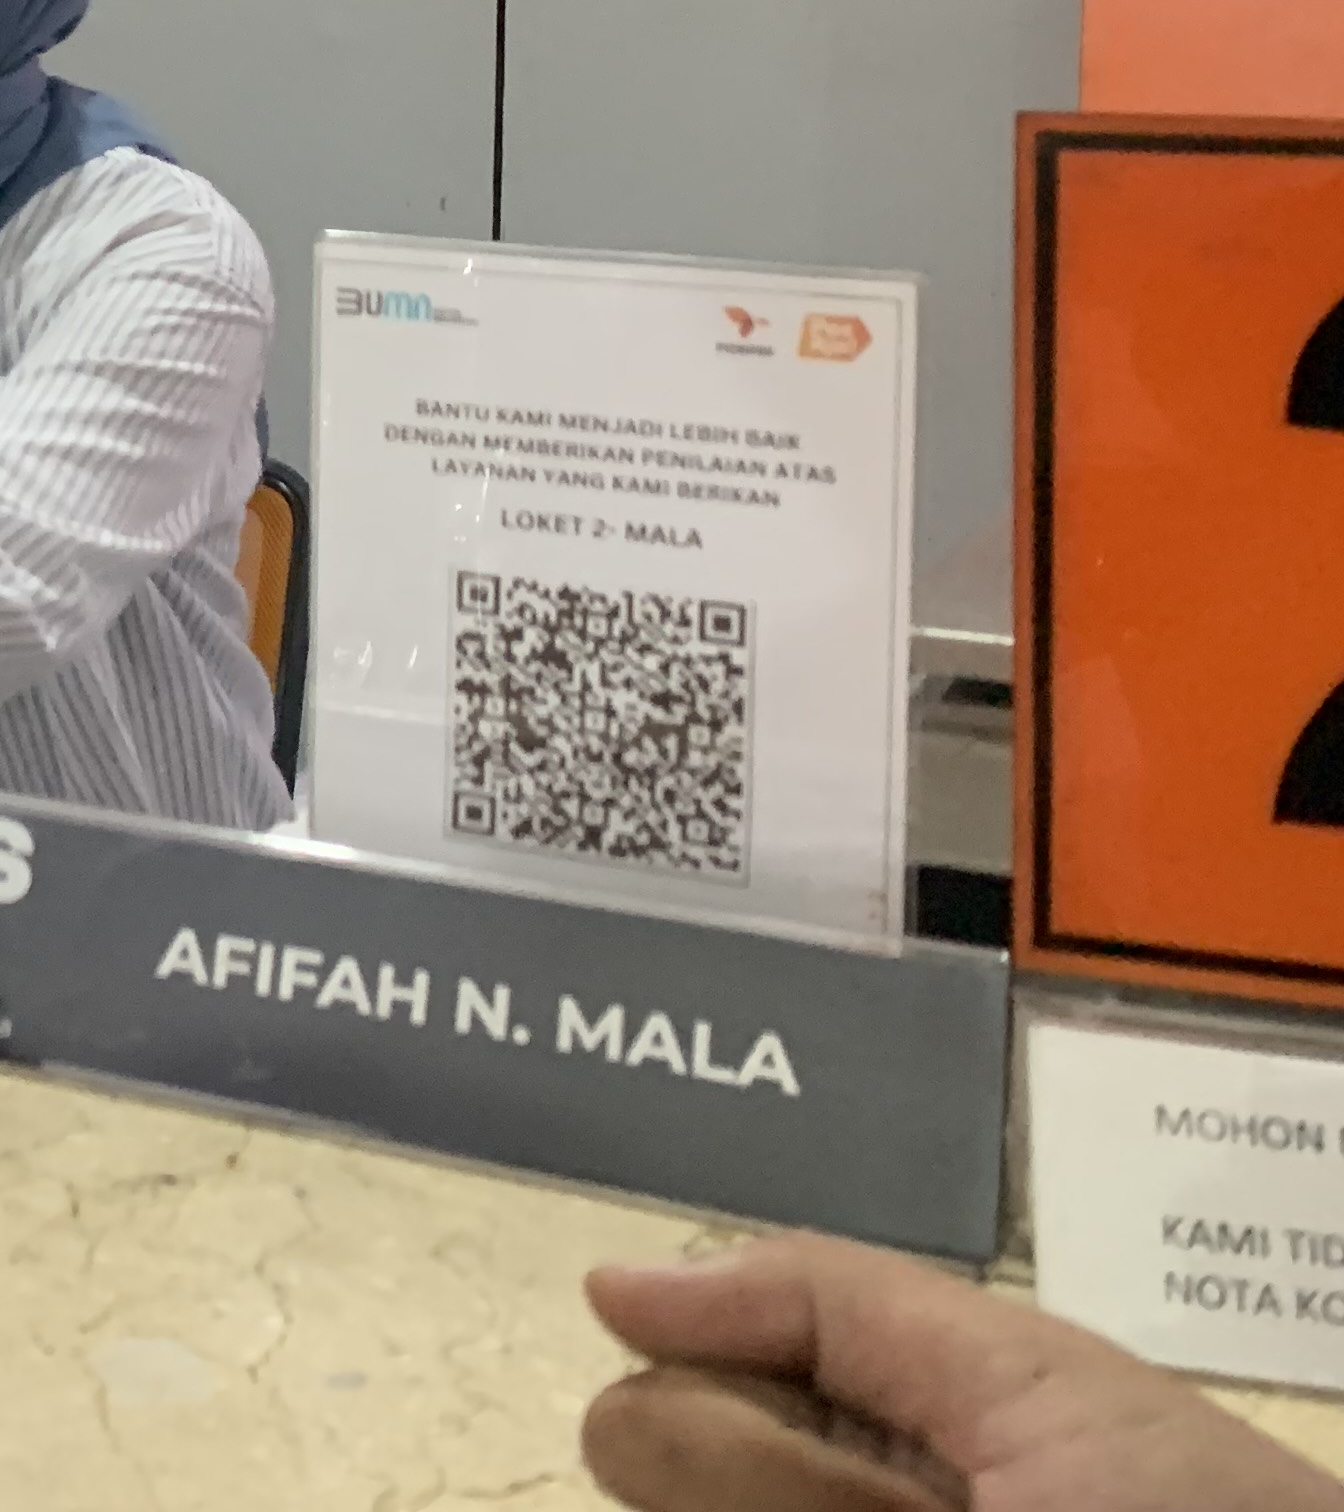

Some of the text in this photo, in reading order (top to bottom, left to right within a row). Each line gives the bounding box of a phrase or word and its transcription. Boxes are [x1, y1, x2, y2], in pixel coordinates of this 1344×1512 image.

[415, 398, 800, 450] BANTU KAMI MENJADI LEBIH BAIK
[384, 423, 837, 485] DENGAN MEMBERIKAN PENILAIAN ATAS
[431, 457, 781, 508] LAYANAN YANG KAMI BERIKAN
[501, 508, 581, 536] LOKET
[624, 520, 703, 549] MALA
[154, 925, 801, 1097] AFIFAH N. MALA
[1155, 1103, 1325, 1155] MOHON
[1161, 1214, 1270, 1260] KAMI
[1165, 1271, 1283, 1319] NOTA
